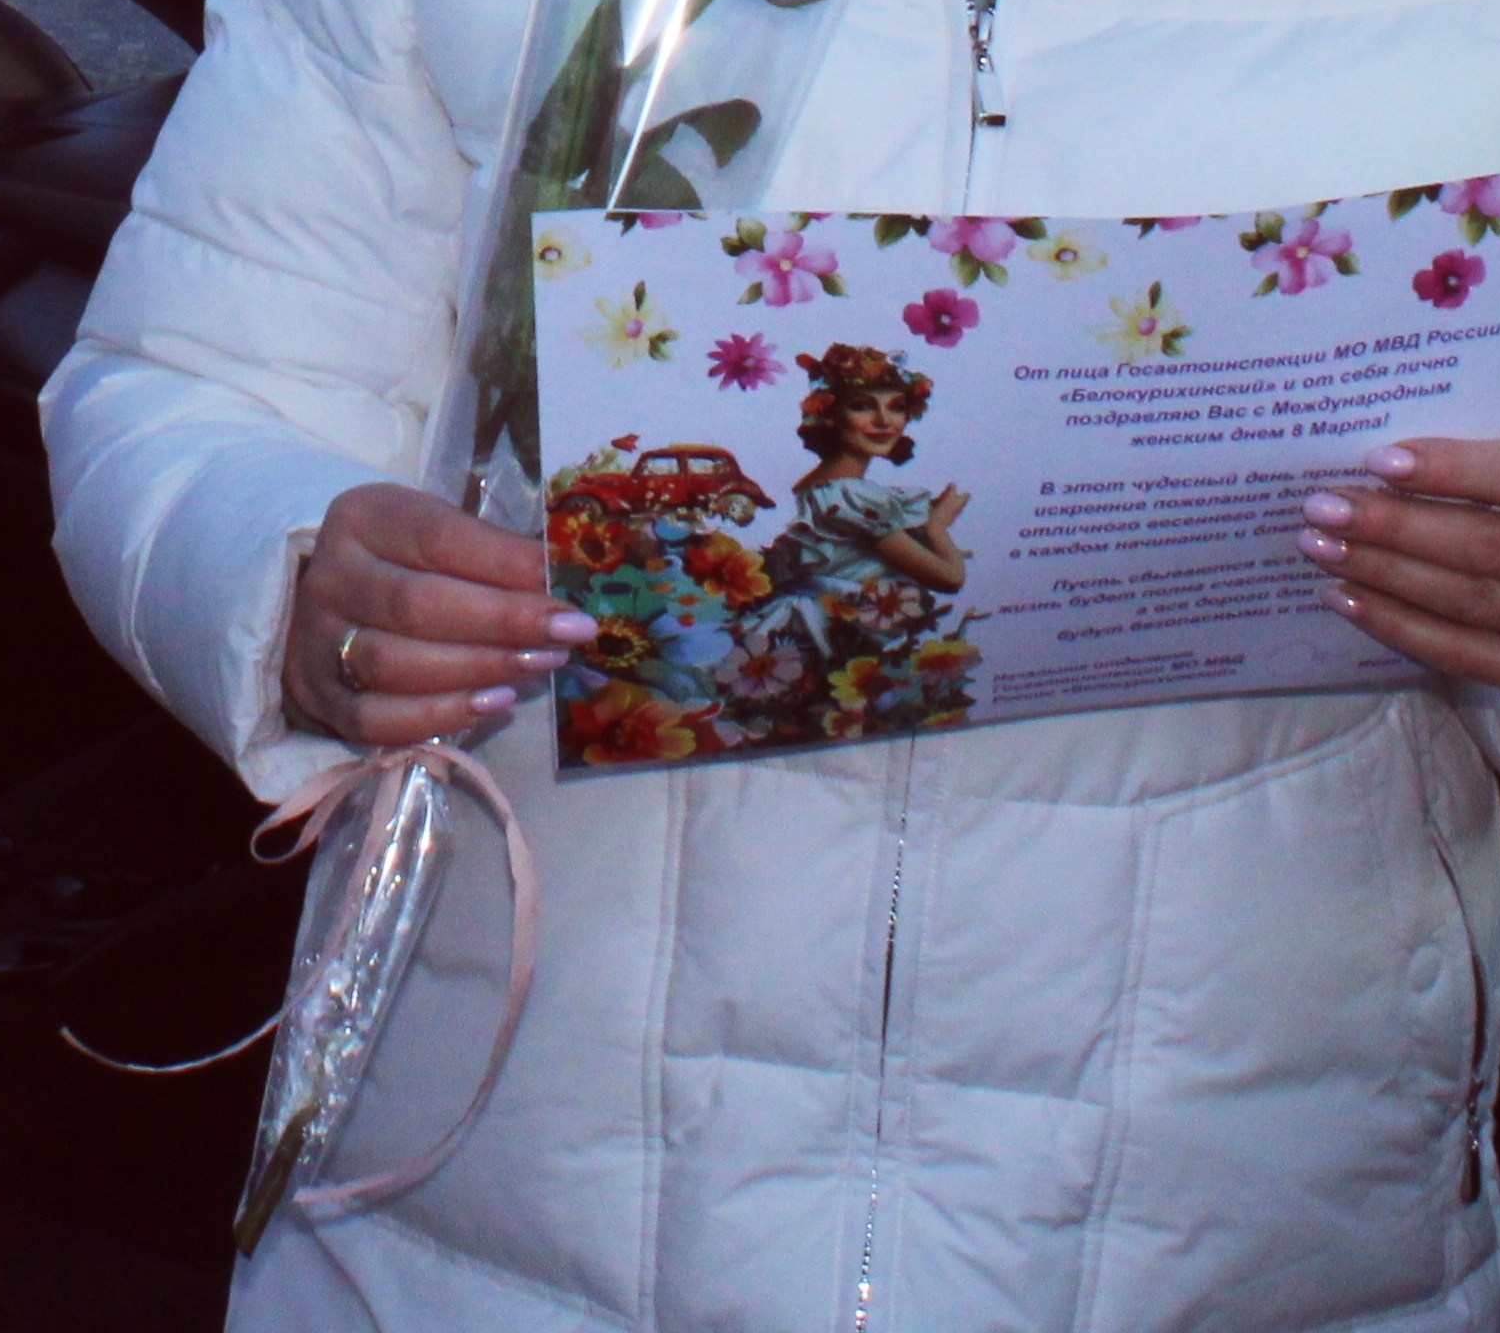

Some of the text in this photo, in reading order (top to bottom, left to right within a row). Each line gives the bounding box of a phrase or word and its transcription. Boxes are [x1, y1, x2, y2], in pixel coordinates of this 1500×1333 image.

[1014, 364, 1051, 381] От
[1056, 365, 1109, 381] лица
[1116, 349, 1326, 378] Госавтоинспекции
[1333, 341, 1367, 361] МО
[1373, 332, 1421, 353] МВД
[1059, 355, 1460, 404] «Белокурихинский» и от себя лично
[1065, 381, 1452, 428] поздравляю Вас с Международным
[1130, 412, 1391, 448] женским днем 8 Марта!
[1040, 468, 1369, 496] В этот чудесный день прими
[1034, 500, 1147, 519] искренние
[1153, 493, 1271, 510] пожелания
[1019, 520, 1140, 538] отличного
[1147, 510, 1256, 530] весеннего
[1026, 540, 1109, 558] каждом
[1234, 529, 1246, 539] и
